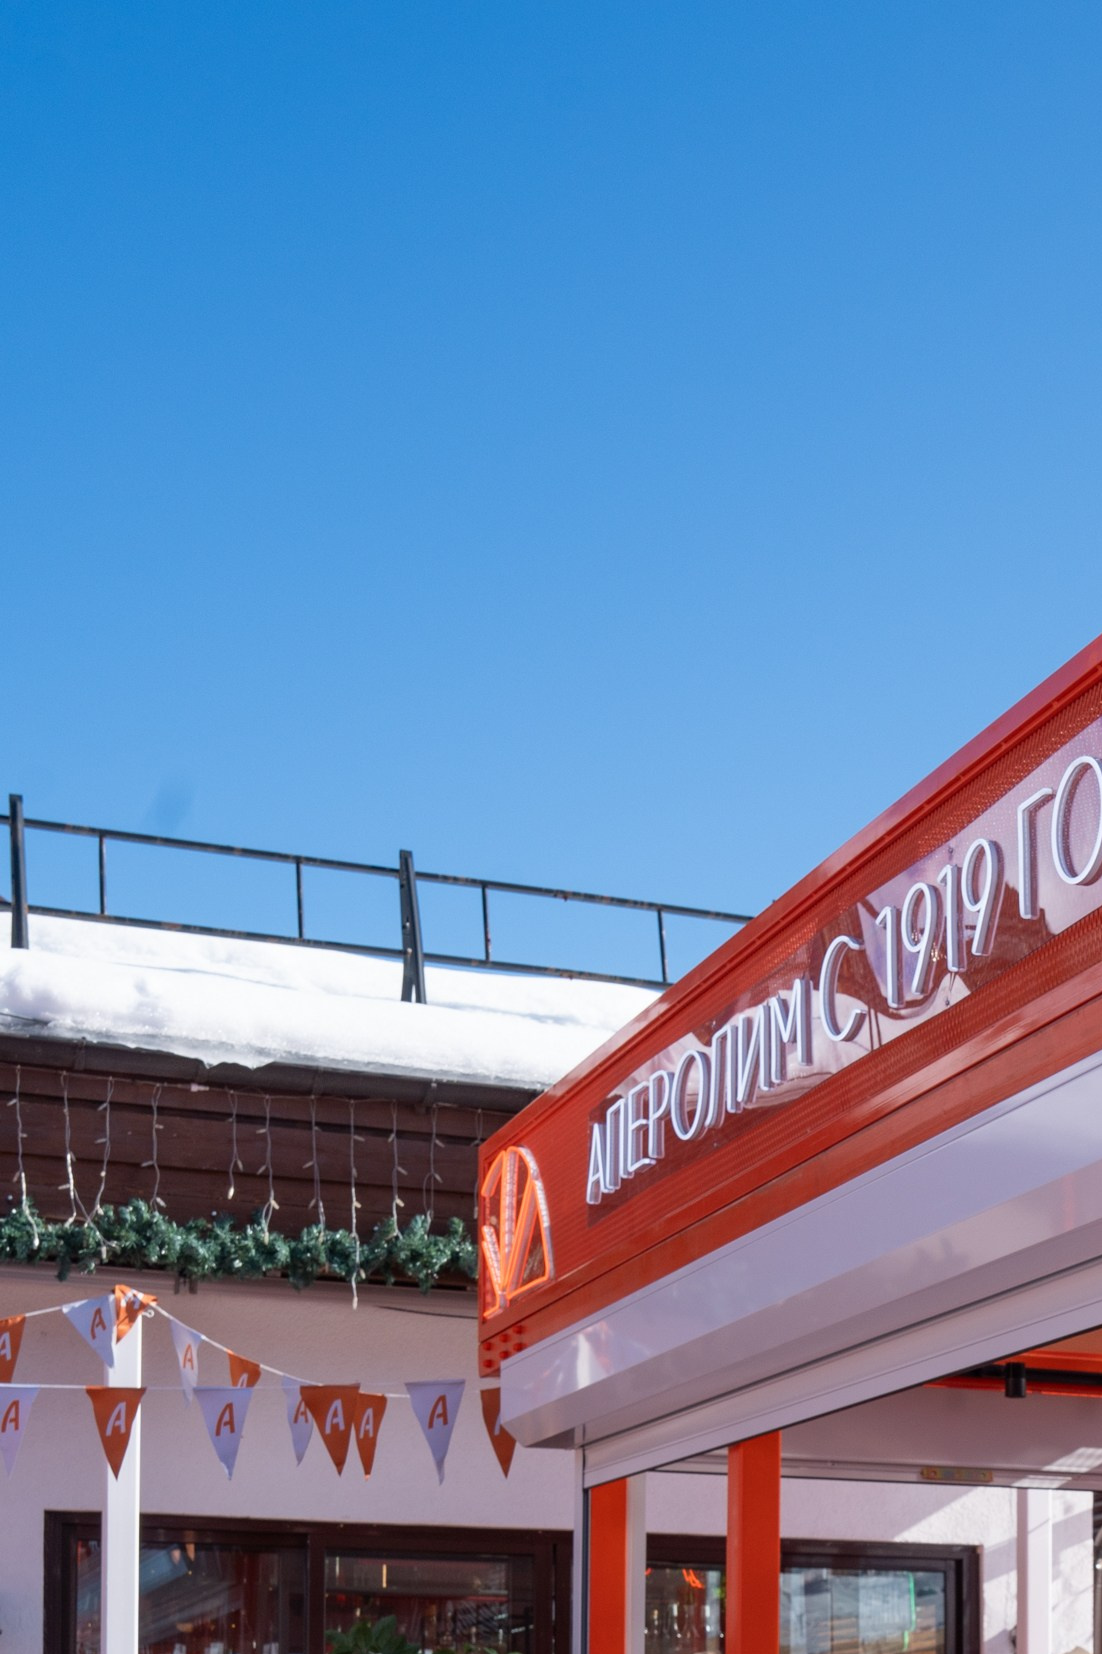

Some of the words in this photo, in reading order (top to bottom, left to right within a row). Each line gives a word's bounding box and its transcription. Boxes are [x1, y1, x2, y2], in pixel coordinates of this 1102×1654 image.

[586, 978, 813, 1205] АПЕРОЛИМ
[819, 934, 867, 1042] С
[875, 838, 1002, 1009] 1919
[91, 1307, 107, 1340] A
[183, 1344, 194, 1370] A
[1, 1400, 20, 1433] A
[105, 1401, 126, 1437] A
[215, 1402, 236, 1437] A
[293, 1399, 309, 1424] A
[325, 1399, 345, 1435] A
[359, 1408, 374, 1439] A
[428, 1394, 448, 1430] A
